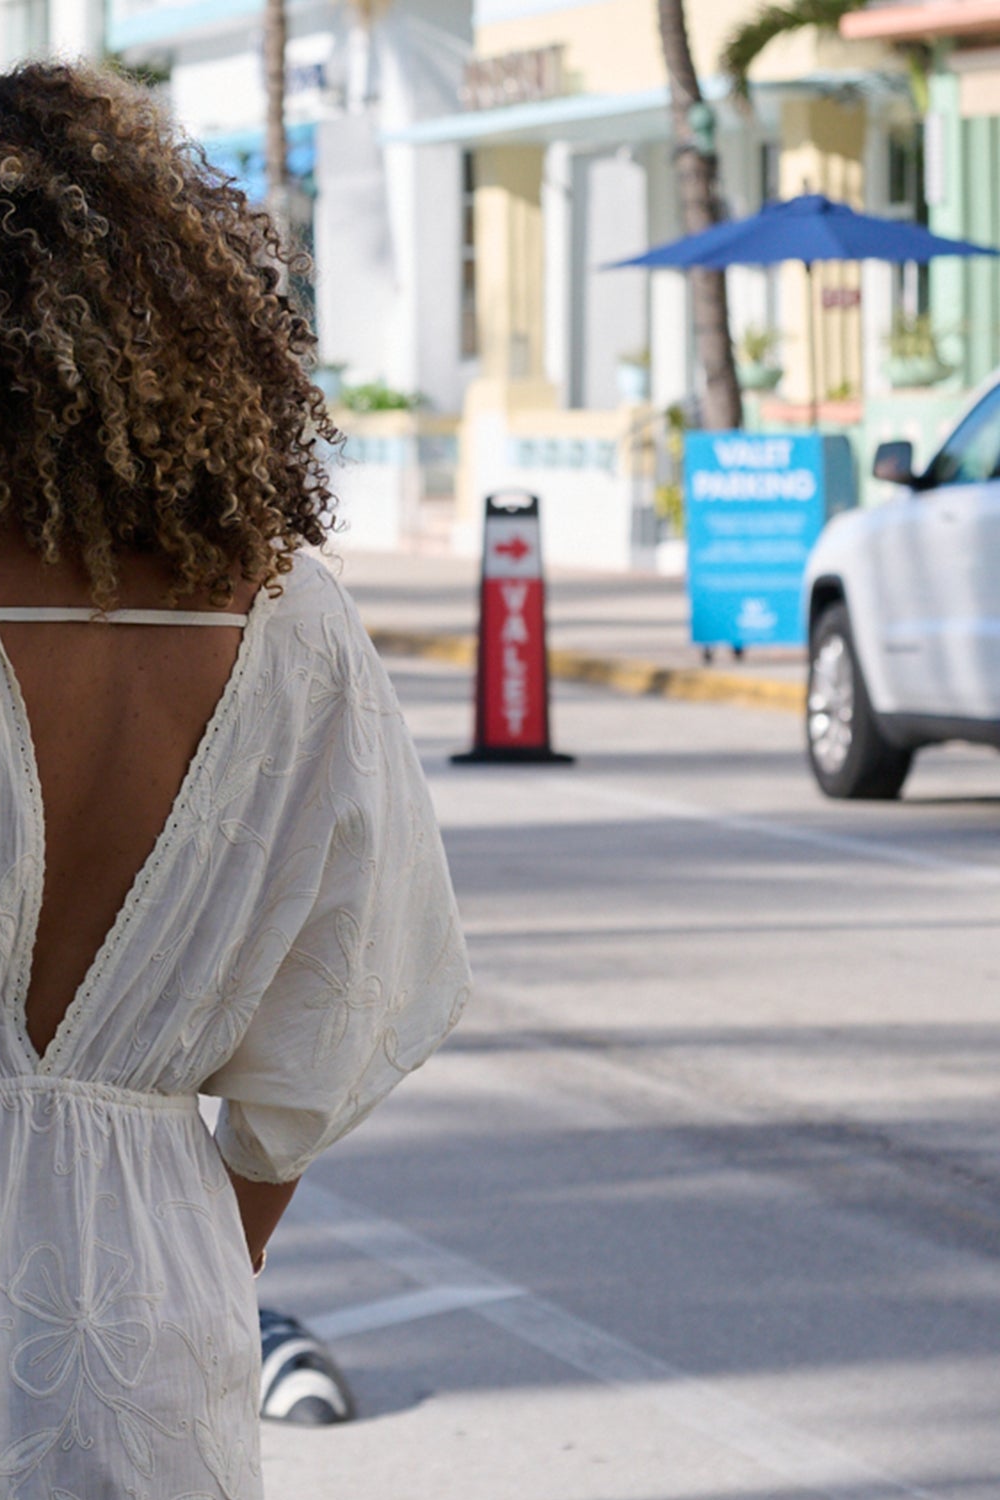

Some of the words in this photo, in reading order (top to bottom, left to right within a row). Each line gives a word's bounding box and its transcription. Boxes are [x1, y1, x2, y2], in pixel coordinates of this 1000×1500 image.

[714, 439, 791, 467] VALET
[693, 470, 815, 500] PARKING
[501, 584, 528, 737] VALET
